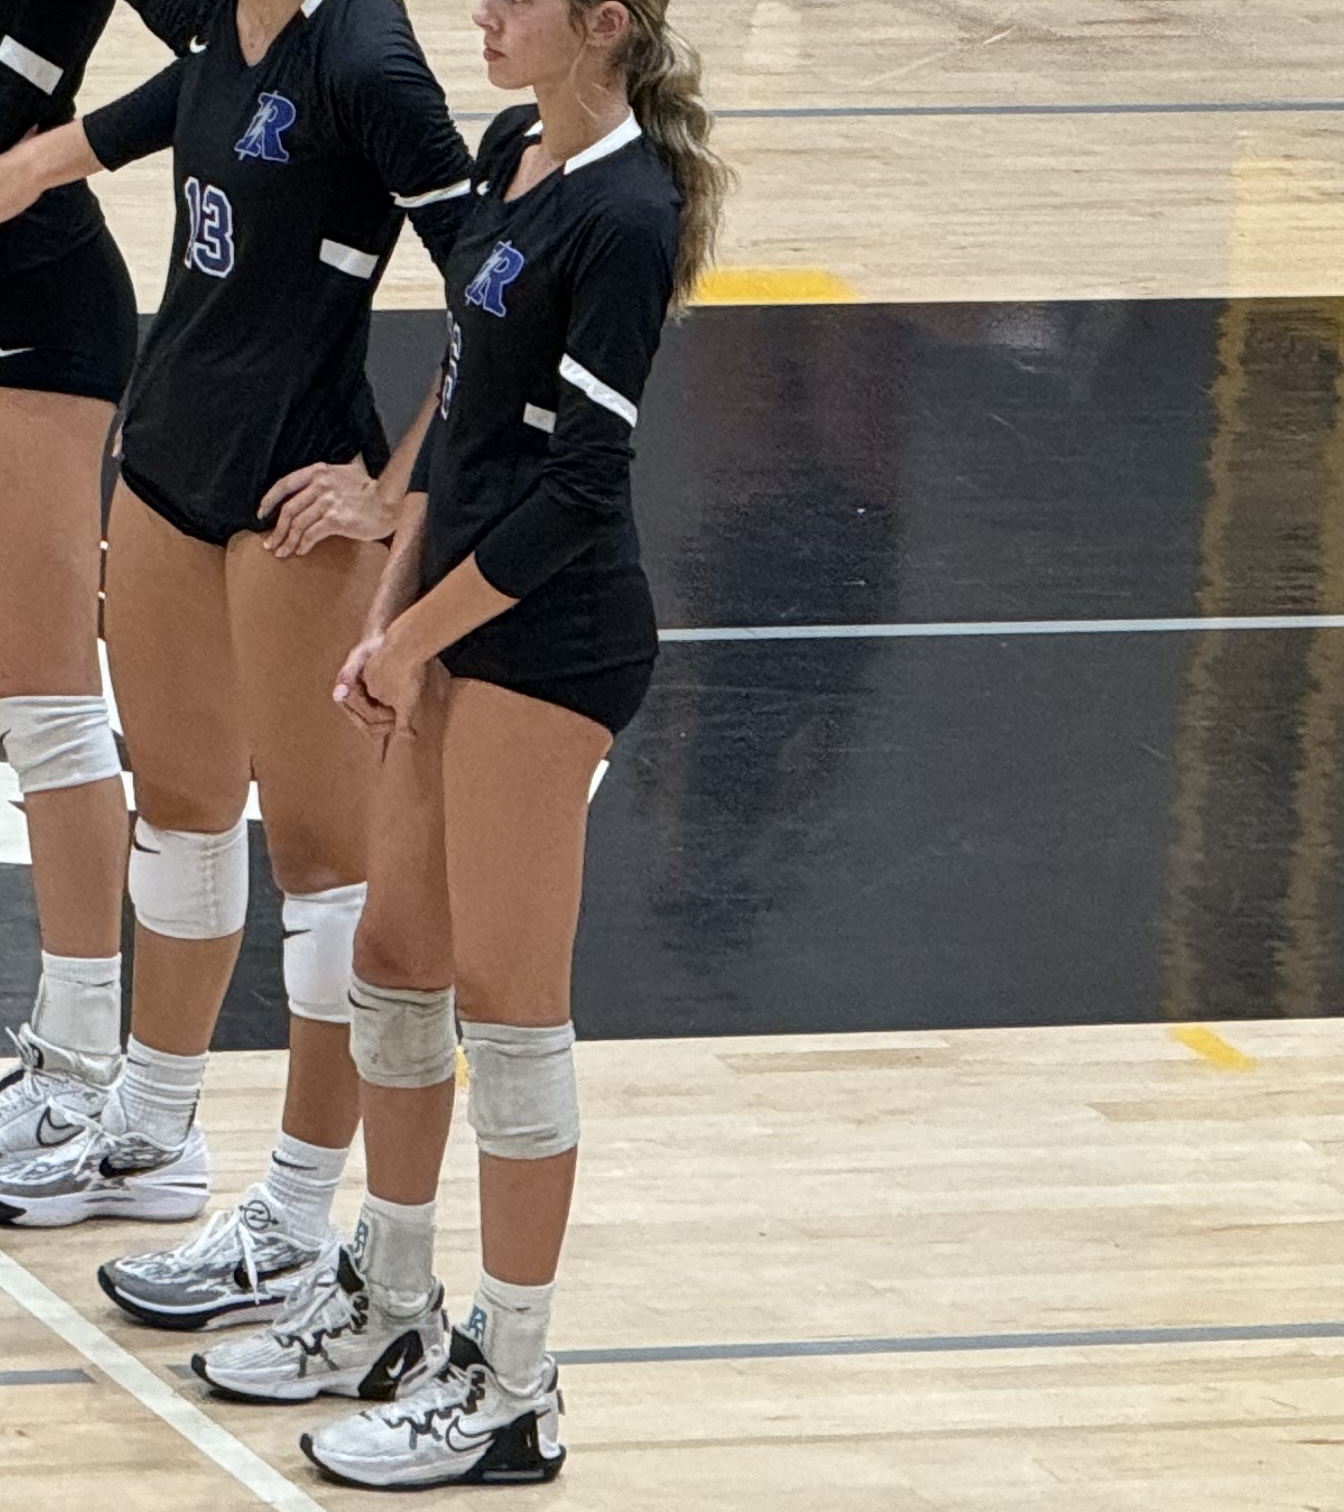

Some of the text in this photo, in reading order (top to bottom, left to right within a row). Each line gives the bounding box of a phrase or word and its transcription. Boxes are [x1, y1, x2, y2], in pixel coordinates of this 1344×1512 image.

[234, 90, 297, 163] R
[184, 176, 236, 279] 13
[465, 240, 525, 318] R
